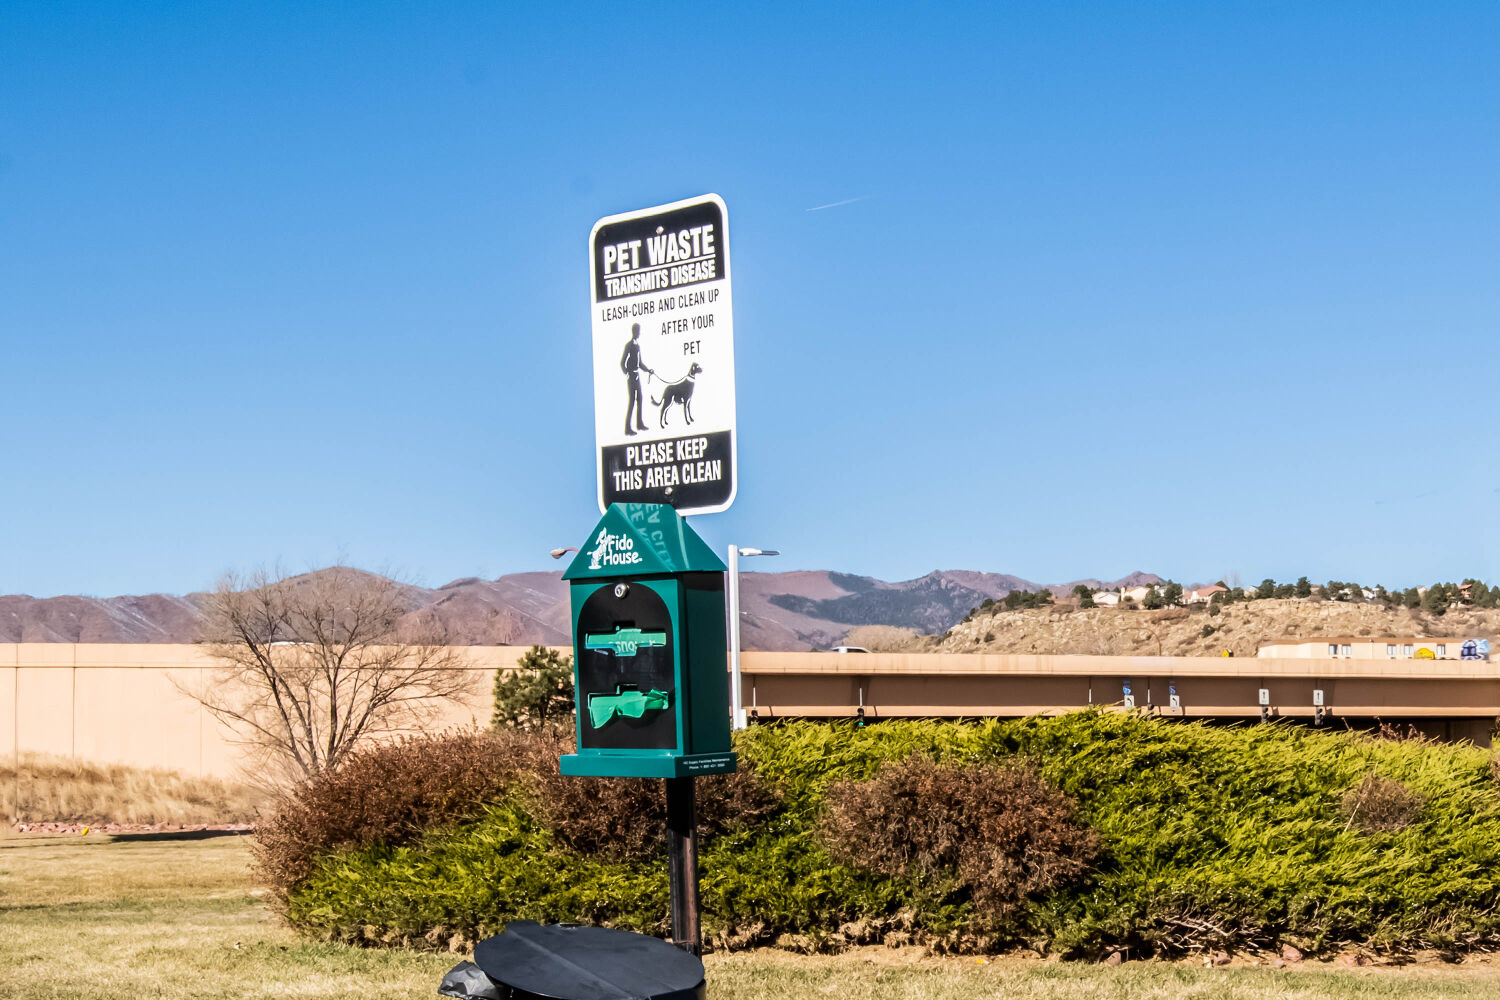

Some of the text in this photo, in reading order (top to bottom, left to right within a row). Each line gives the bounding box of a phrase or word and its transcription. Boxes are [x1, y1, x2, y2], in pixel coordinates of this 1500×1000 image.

[604, 224, 714, 274] PET WASTE
[605, 259, 716, 297] TRANSMITS DISEASE
[602, 288, 720, 322] LEASH-CURB AND CLEAN UP
[661, 314, 714, 335] AFTER YOUR
[683, 340, 701, 355] PET
[626, 437, 708, 467] PLEASE KEEP
[613, 459, 722, 492] THIS AREA CLEAN
[607, 534, 633, 550] Fido
